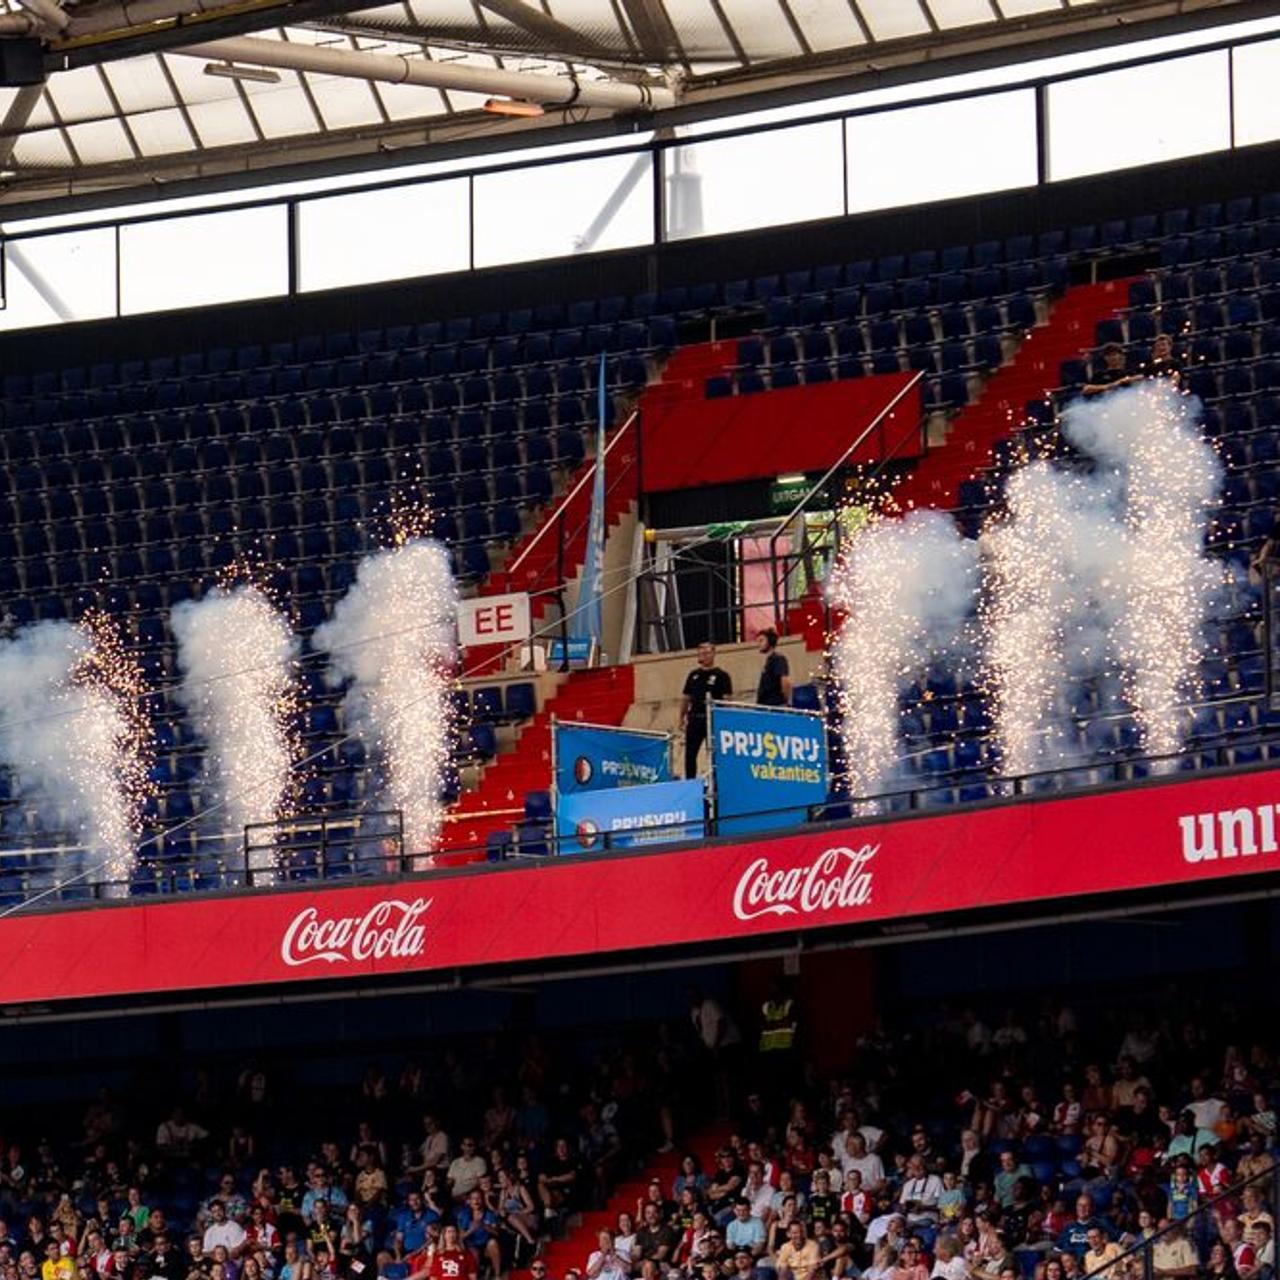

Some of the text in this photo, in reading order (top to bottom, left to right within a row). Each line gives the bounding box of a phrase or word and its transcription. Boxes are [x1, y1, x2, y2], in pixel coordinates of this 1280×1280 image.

[476, 604, 513, 634] EE
[751, 761, 820, 784] vakanties
[1178, 803, 1280, 863] uni
[733, 843, 881, 920] Coca-Cola
[281, 896, 433, 966] Coca-Cola
